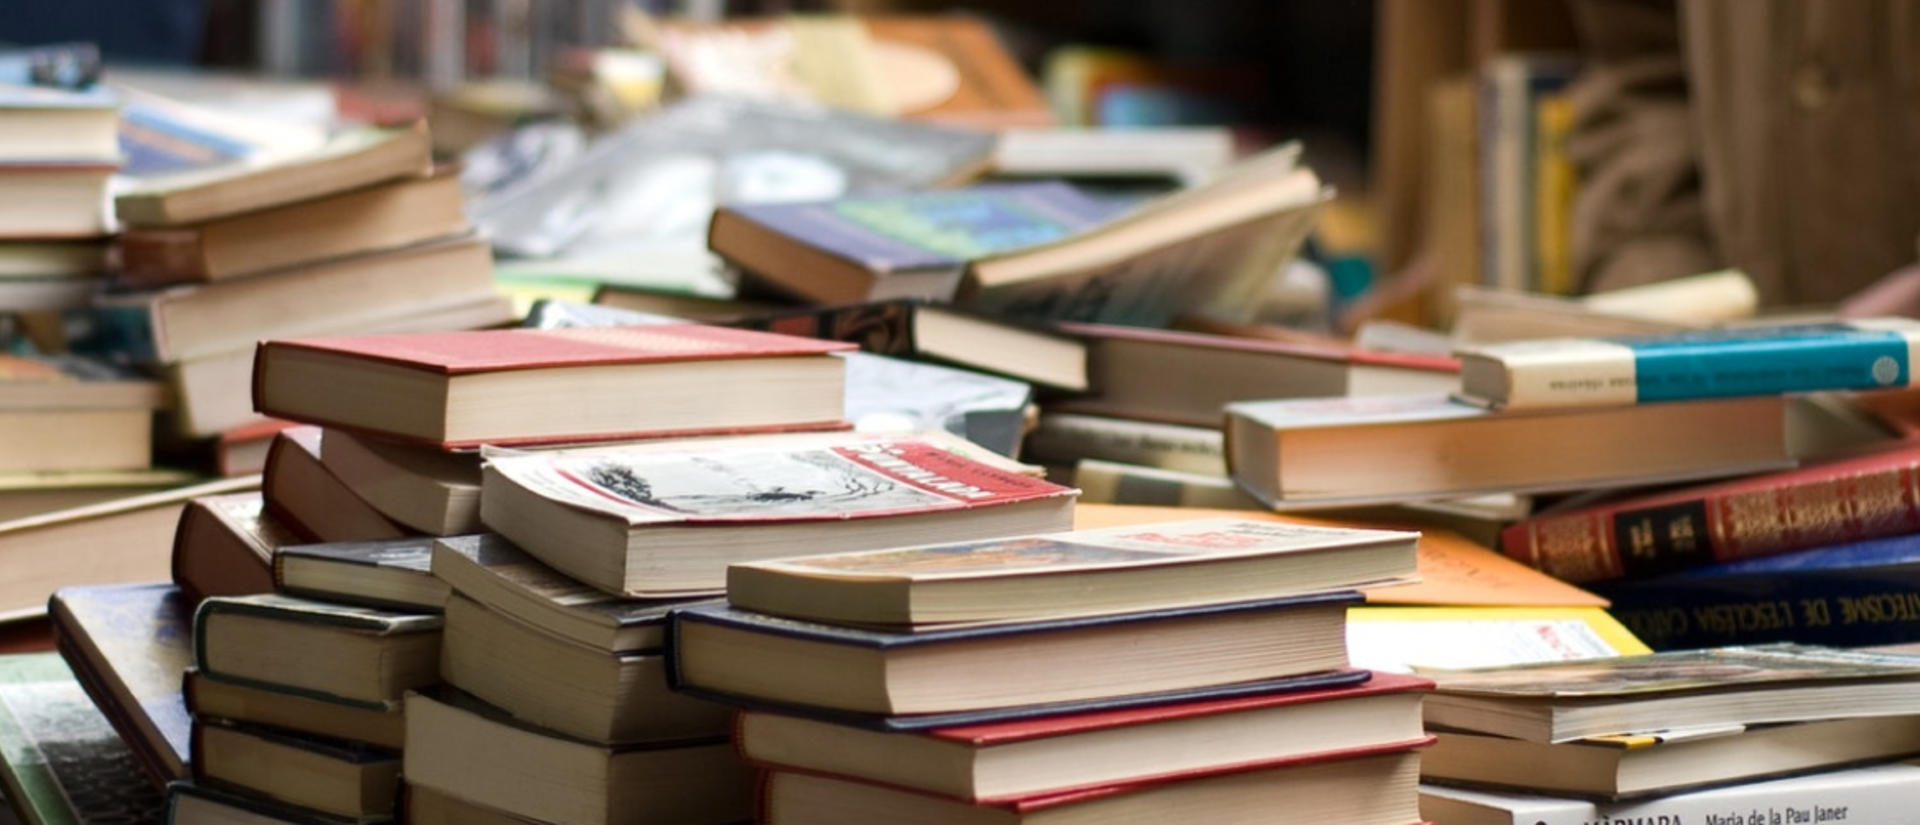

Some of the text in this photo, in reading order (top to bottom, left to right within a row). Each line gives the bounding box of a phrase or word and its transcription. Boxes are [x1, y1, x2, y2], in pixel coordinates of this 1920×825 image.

[1804, 598, 1831, 627] DE
[1748, 809, 1765, 825] de
[1769, 807, 1781, 825] la
[1786, 807, 1810, 824] Pau
[1814, 805, 1848, 824] Janer
